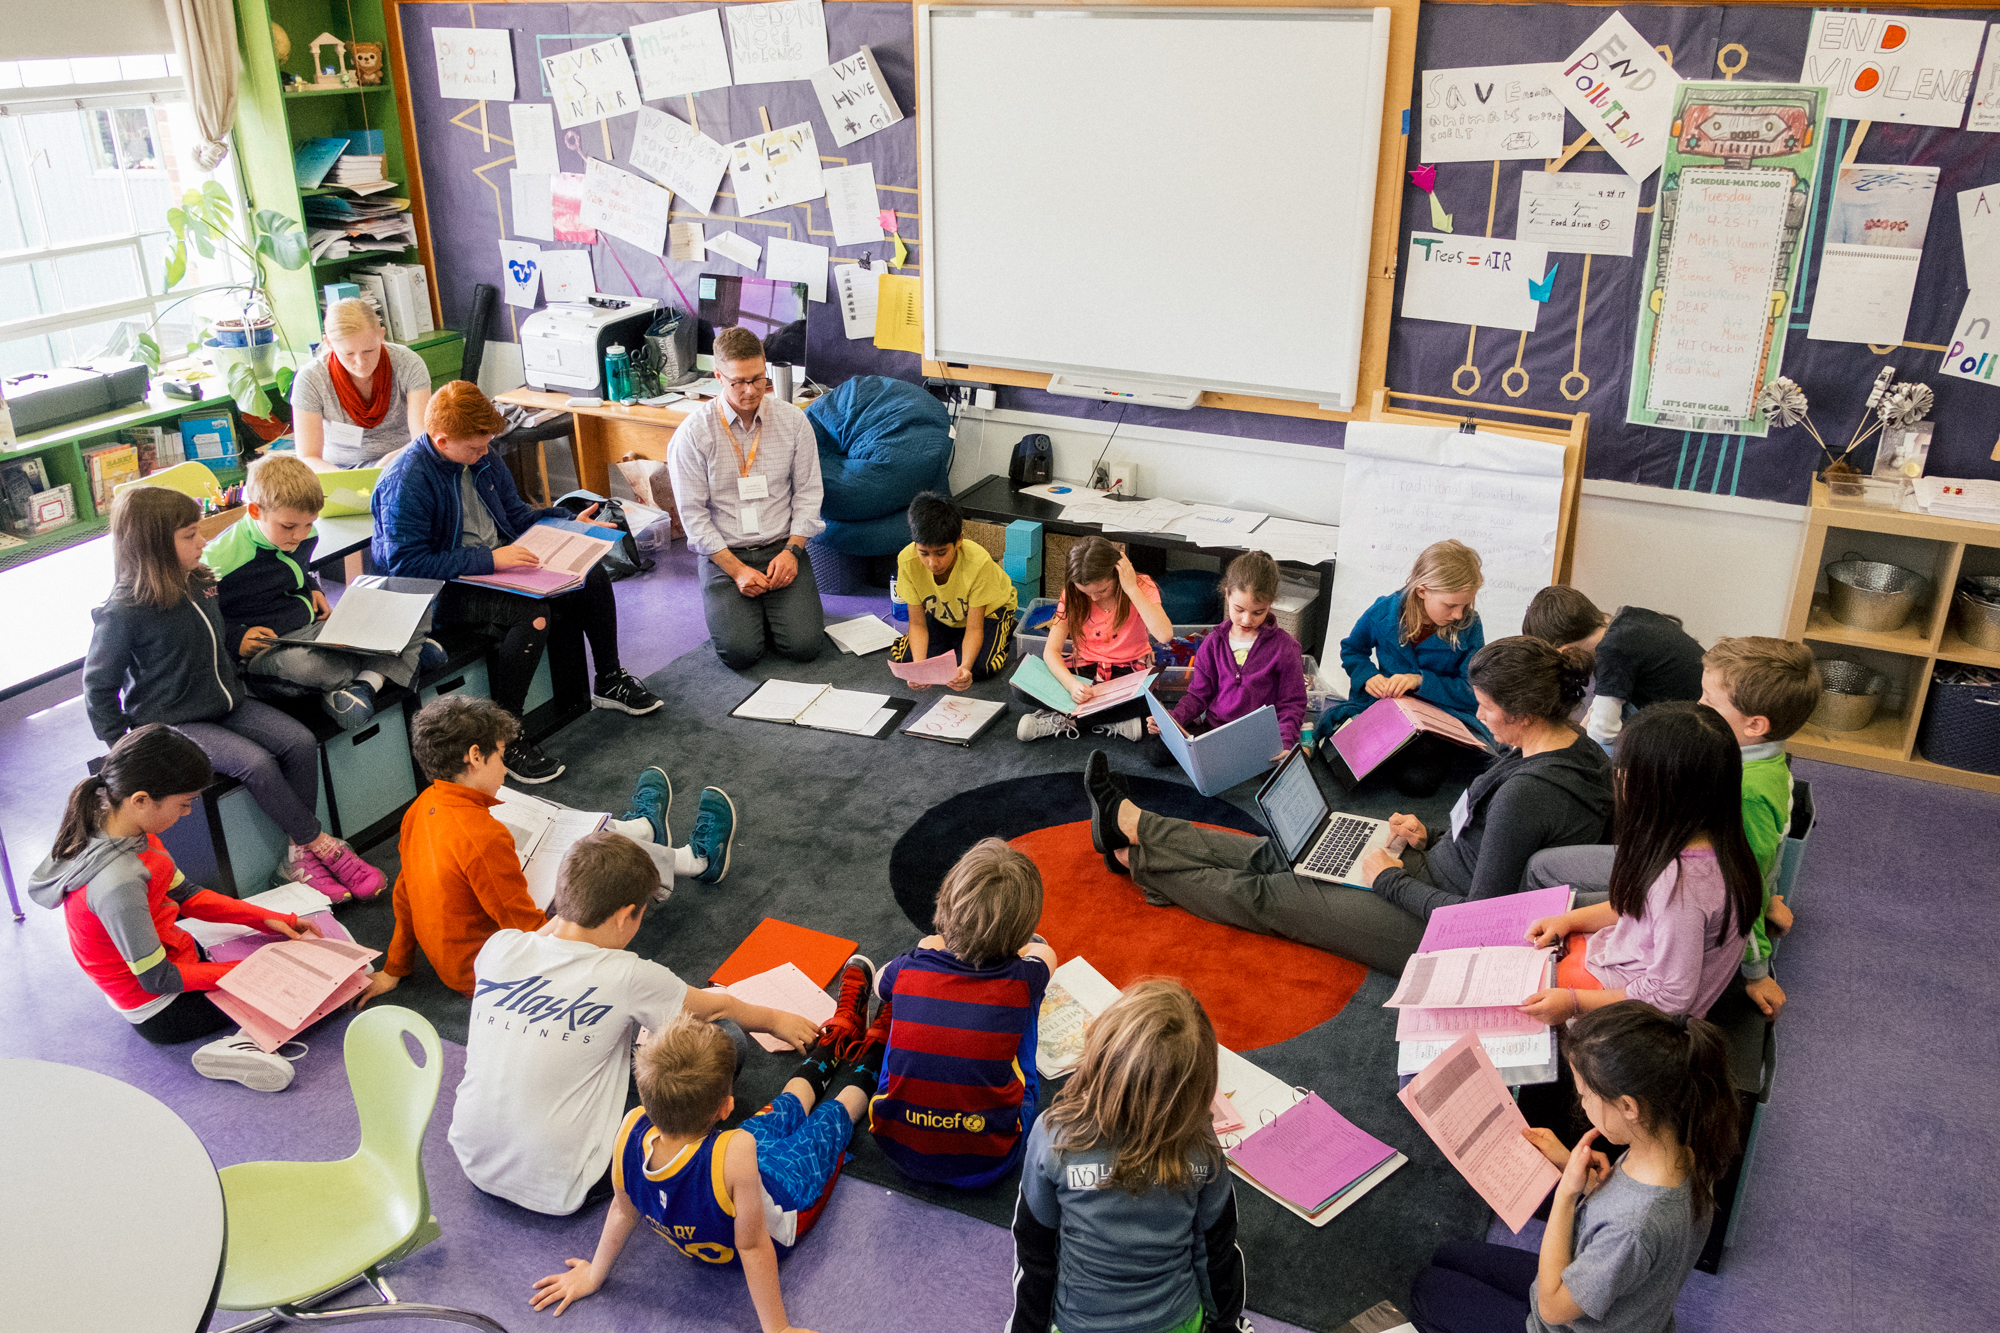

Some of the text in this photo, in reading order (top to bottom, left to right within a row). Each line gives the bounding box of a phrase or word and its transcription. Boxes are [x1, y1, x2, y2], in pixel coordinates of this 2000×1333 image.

[1819, 16, 1911, 55] END
[832, 56, 867, 82] WE
[1594, 33, 1657, 91] END
[1809, 55, 1975, 105] VIOLENCE
[831, 82, 875, 110] HAVE
[1690, 178, 1781, 189] SCHEDULE-MATIC 3000
[1701, 186, 1752, 206] Tuesday
[1686, 201, 1717, 216] April
[1747, 204, 1775, 217] 2017
[1550, 217, 1568, 228] Food
[1571, 218, 1592, 228] drive
[1706, 215, 1759, 230] 4-25-17
[1687, 233, 1769, 249] Math Vitamin
[1413, 237, 1465, 264] Trees
[1484, 251, 1512, 272] AIR
[1677, 256, 1767, 274] PE Science
[1674, 268, 1748, 285] Science PE
[1676, 300, 1709, 315] DEAR
[1669, 313, 1700, 326] Music
[1720, 327, 1749, 342] Music
[1665, 363, 1691, 375] Read
[1662, 399, 1681, 407] LET'S
[1682, 401, 1697, 409] GET
[1697, 402, 1706, 410] IN
[1388, 473, 1529, 509] Traditional knowledge
[1452, 511, 1483, 525] people
[1490, 514, 1515, 527] know
[1388, 519, 1414, 531] about
[1458, 527, 1495, 543] change
[1488, 578, 1517, 589] ocean
[475, 975, 614, 1033] Alaska
[1051, 1020, 1083, 1041] CLASS
[905, 1109, 962, 1129] unicef
